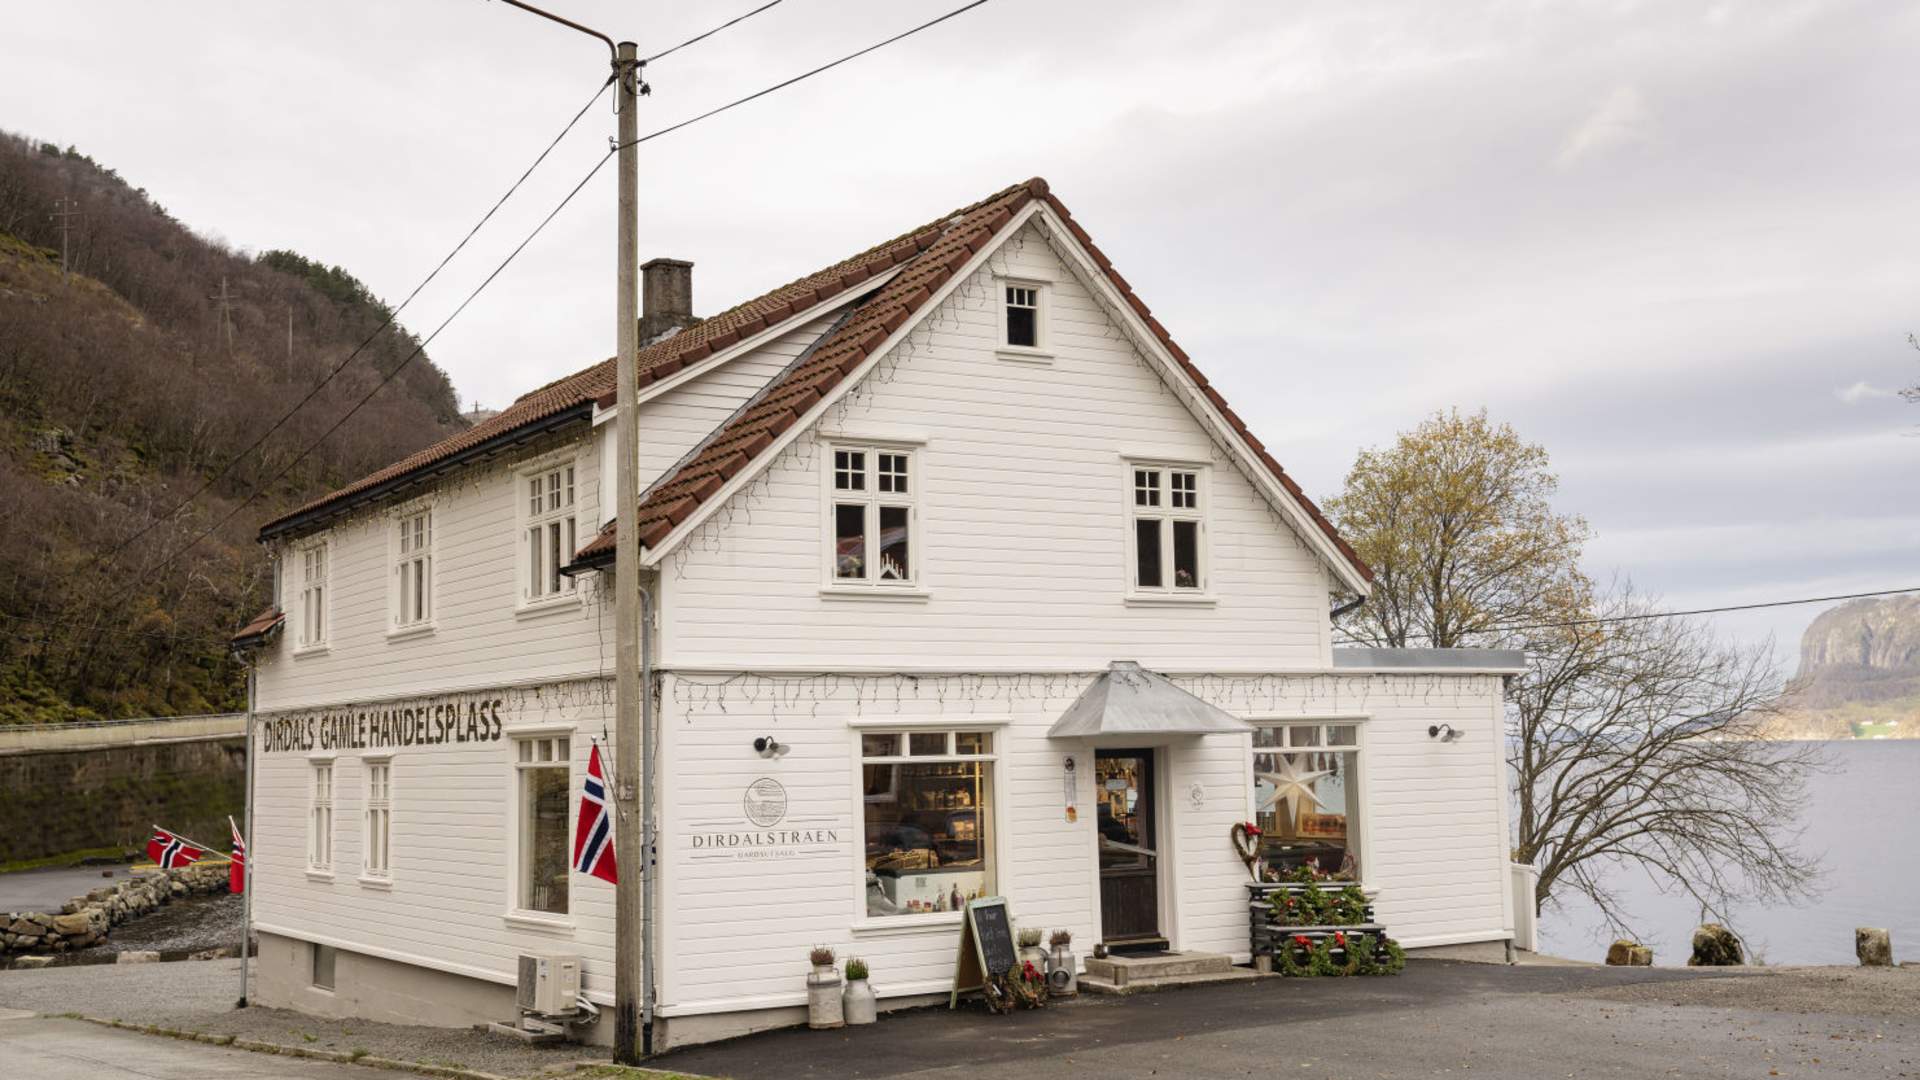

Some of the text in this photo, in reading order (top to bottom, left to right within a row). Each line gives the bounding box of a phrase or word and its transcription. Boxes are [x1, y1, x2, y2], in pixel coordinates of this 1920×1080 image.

[264, 699, 502, 752] DIRDALS GAMLE HANDELSPLASS
[692, 830, 838, 848] DIRDALSTRAEN
